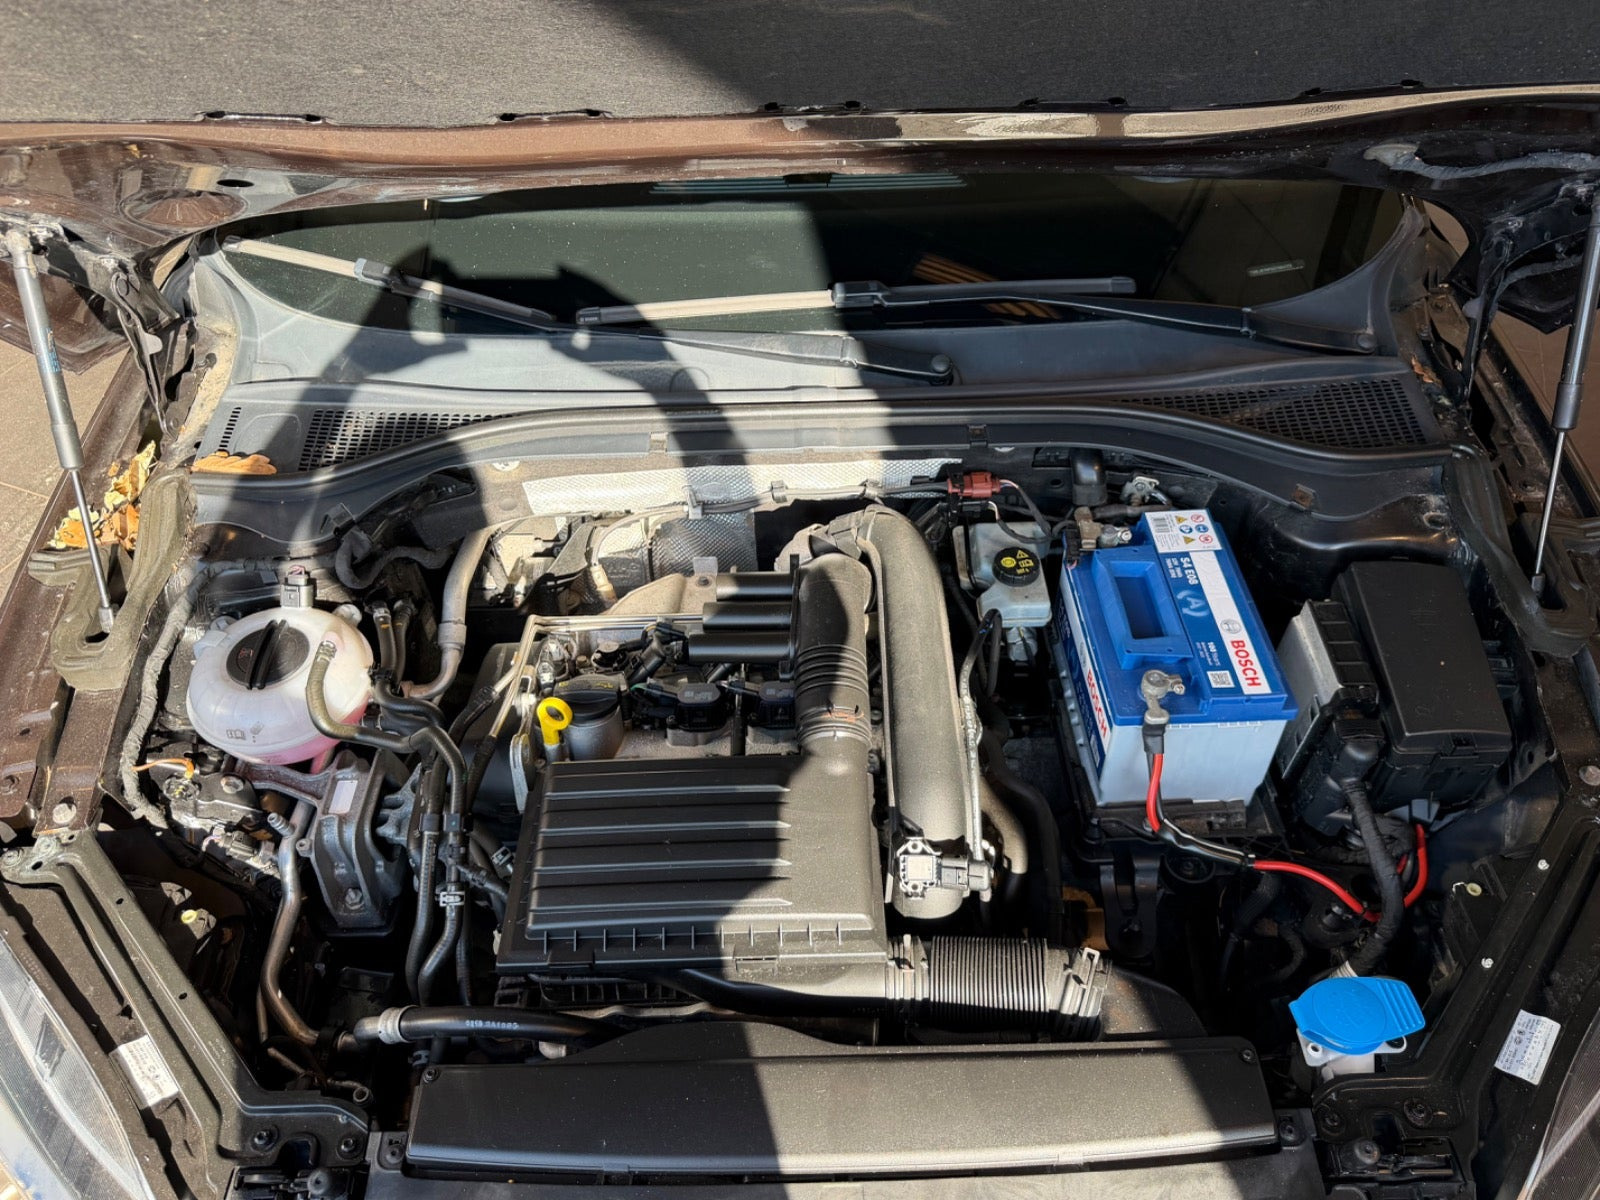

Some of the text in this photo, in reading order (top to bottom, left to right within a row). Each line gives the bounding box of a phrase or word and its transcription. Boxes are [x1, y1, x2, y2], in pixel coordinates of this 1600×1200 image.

[1180, 556, 1193, 568] S4
[1230, 639, 1262, 687] BOSCH
[1087, 668, 1107, 738] BOSCH
